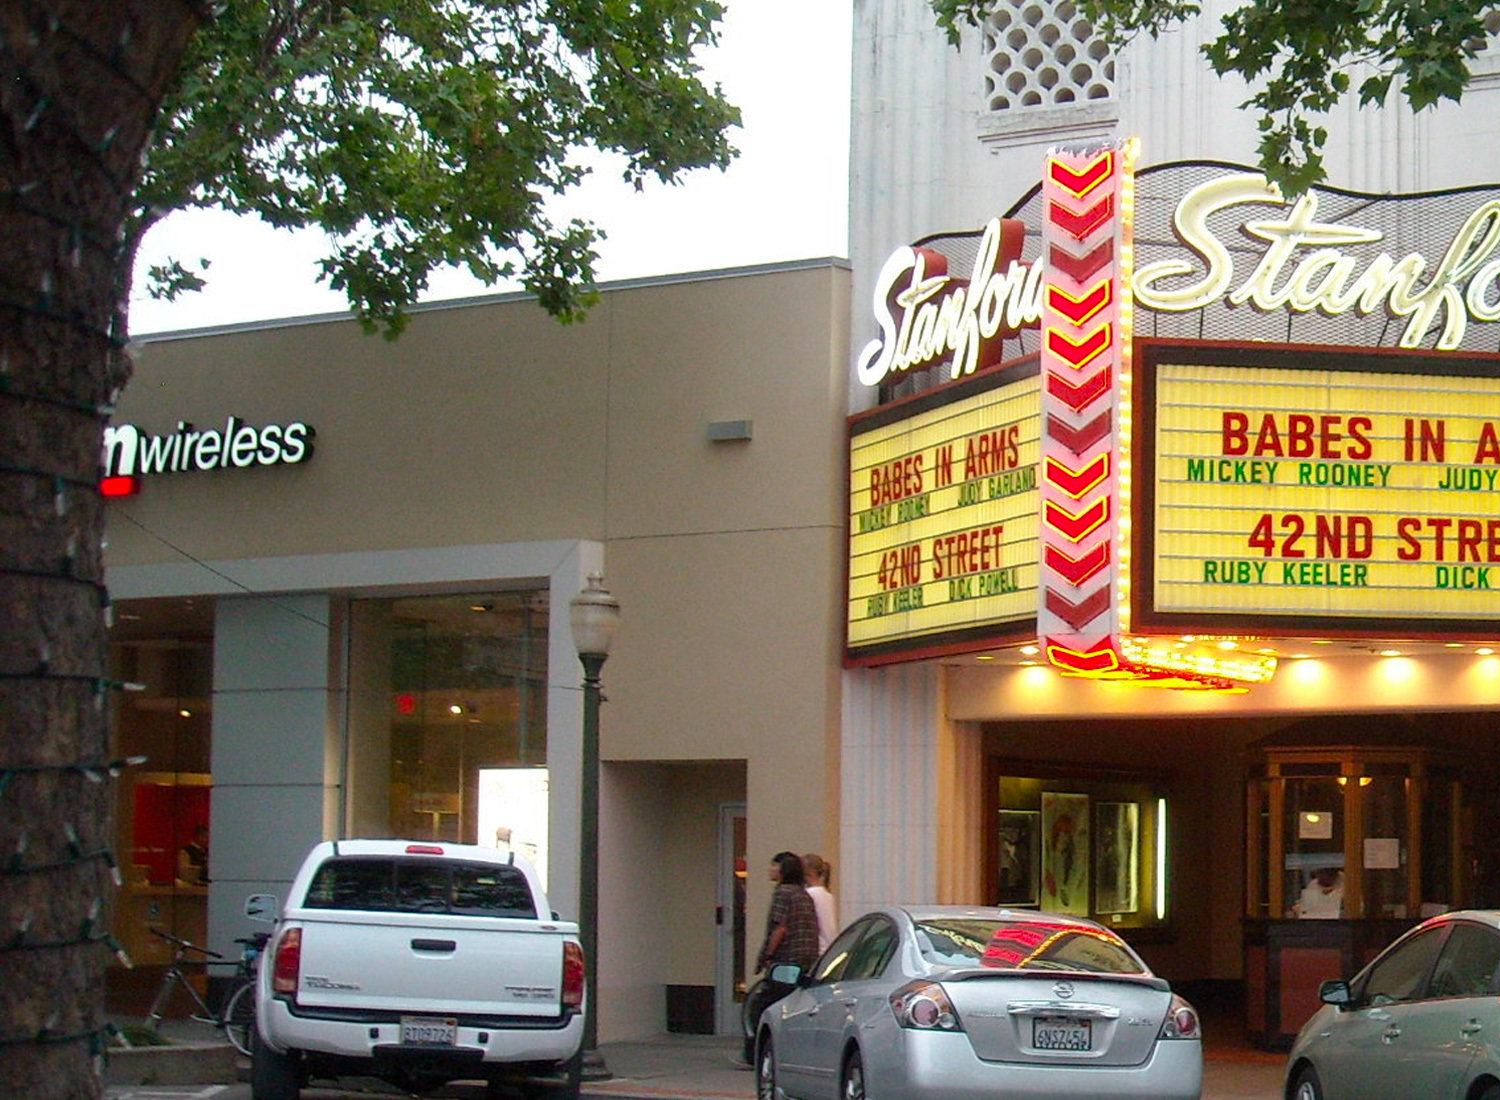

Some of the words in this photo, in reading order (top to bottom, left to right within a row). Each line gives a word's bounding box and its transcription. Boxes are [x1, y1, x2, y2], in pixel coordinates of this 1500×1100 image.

[140, 416, 307, 474] wireless
[1221, 411, 1374, 461] BABES
[1403, 418, 1446, 464] IN
[870, 454, 923, 507] BABES
[935, 444, 953, 489] IN
[964, 425, 1019, 481] ARMS
[1187, 458, 1279, 485] MICKEY
[1299, 462, 1392, 488] ROONEY
[1438, 466, 1499, 492] JUDY
[877, 544, 922, 591] 42ND
[932, 525, 1004, 580] STREET
[1248, 513, 1374, 560] 42ND
[1203, 560, 1268, 584] RUBY
[1283, 562, 1368, 587] KEELER
[1435, 565, 1492, 590] DICK
